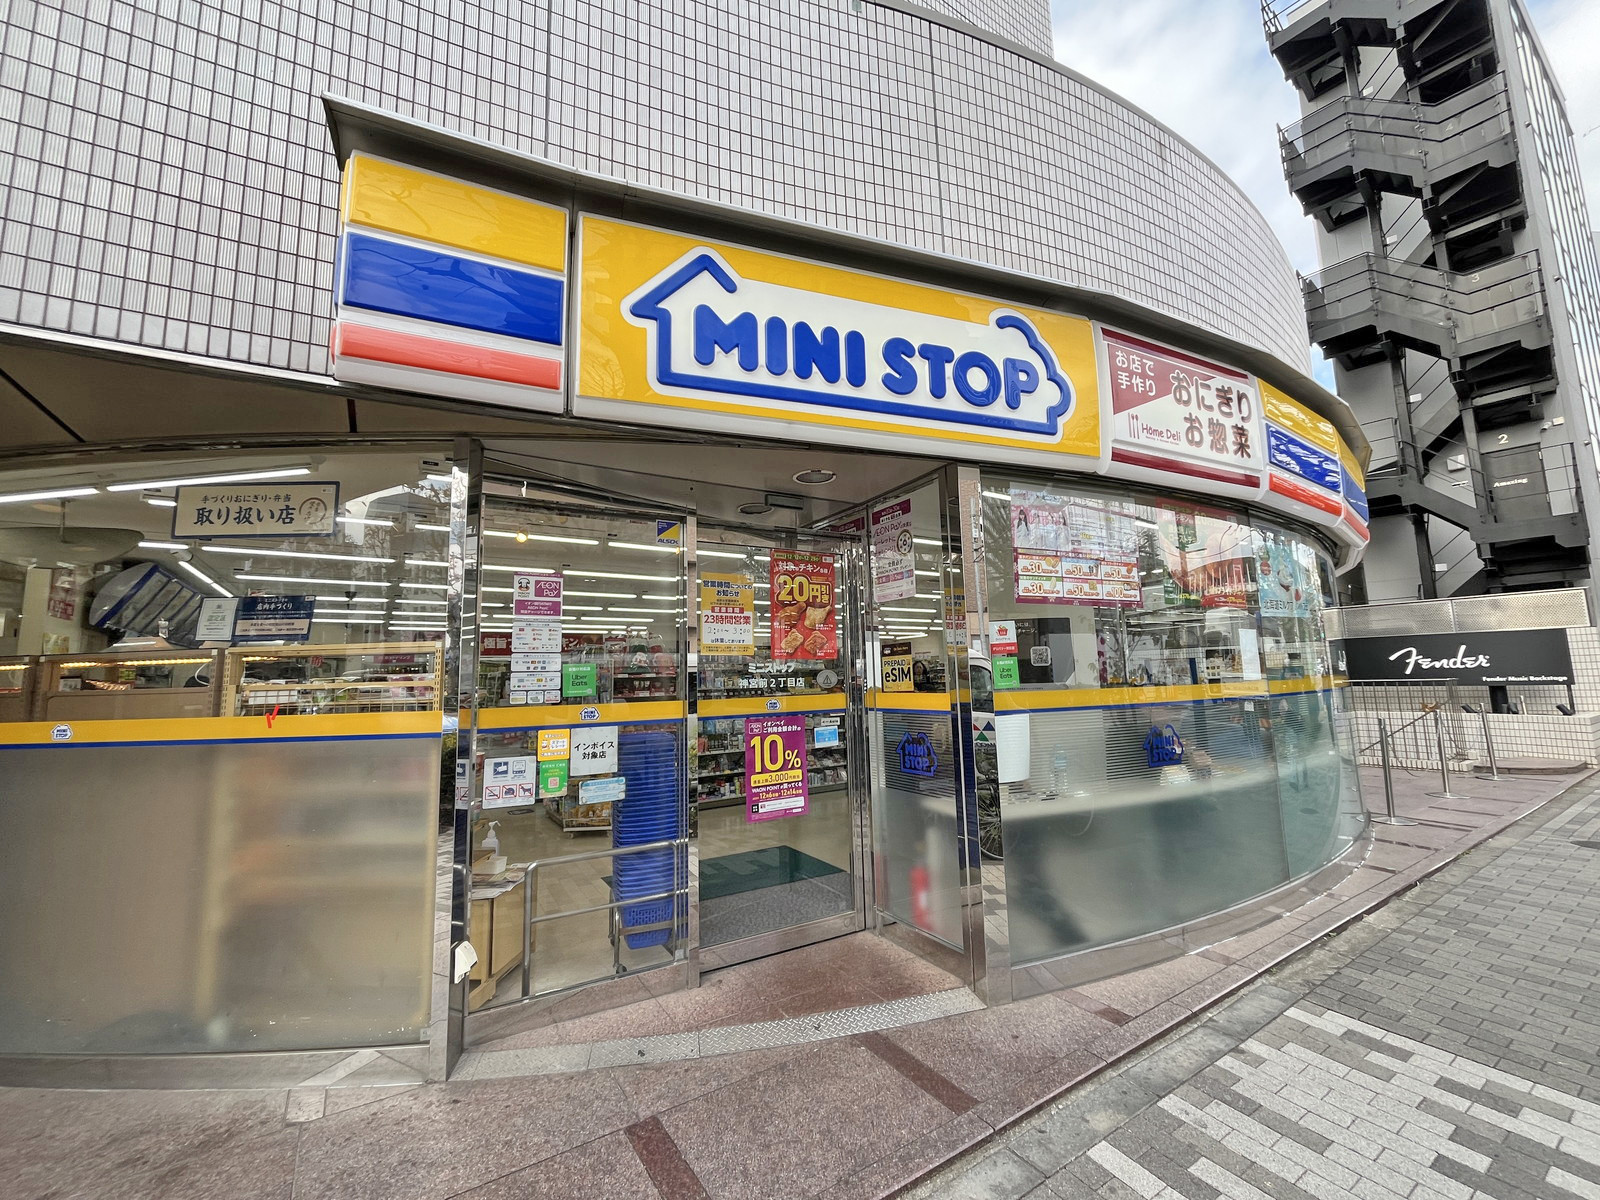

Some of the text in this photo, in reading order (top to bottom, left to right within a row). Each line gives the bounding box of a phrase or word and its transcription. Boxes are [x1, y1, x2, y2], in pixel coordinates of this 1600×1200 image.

[1471, 273, 1480, 283] 3
[695, 303, 1041, 410] MINI STOP
[1115, 350, 1155, 376] お店で
[1117, 371, 1156, 397] 手作り
[1170, 371, 1252, 423] おにぎり
[1141, 422, 1165, 438] Home
[1166, 429, 1182, 442] Deli
[1183, 412, 1252, 459] お惣菜
[1497, 433, 1509, 445] 2
[1493, 478, 1528, 488] Amazing
[194, 505, 297, 526] 取り扱い店
[543, 589, 559, 597] Pay
[704, 614, 752, 625] 23時間営業
[883, 659, 906, 667] PREPAID
[1388, 644, 1491, 675] Fender
[748, 662, 796, 674] ミニストップ
[884, 666, 912, 683] eSIM
[574, 741, 615, 751] インボイス
[750, 734, 802, 773] 10%
[904, 742, 928, 756] MINI
[581, 751, 607, 760] 対象店
[904, 755, 929, 770] STOP
